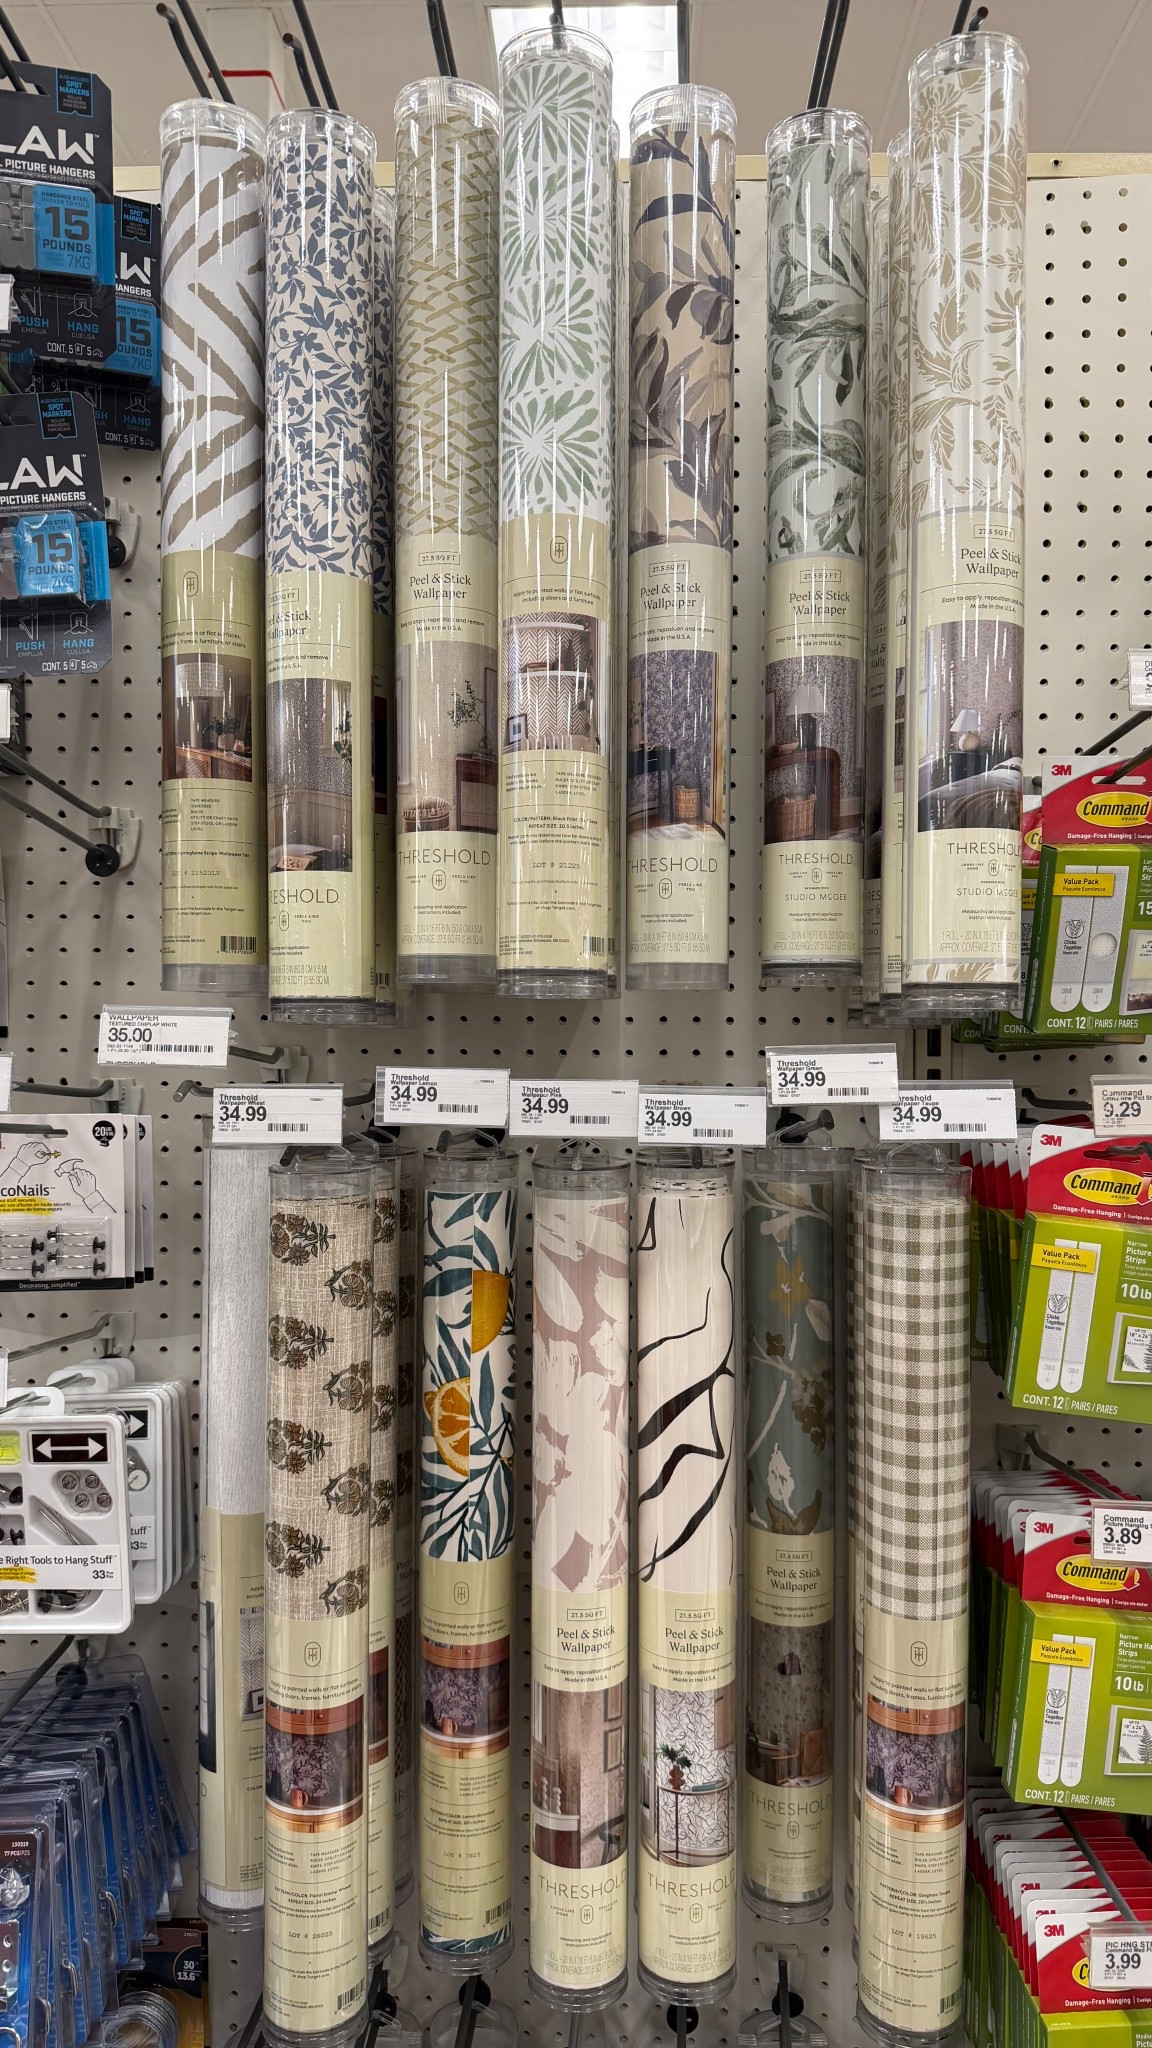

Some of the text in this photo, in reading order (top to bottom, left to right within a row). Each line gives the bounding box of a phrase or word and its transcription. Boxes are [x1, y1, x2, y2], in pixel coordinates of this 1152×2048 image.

[66, 80, 82, 88] SPOT
[60, 86, 90, 96] MARKERS
[5, 158, 47, 173] PICTURE
[50, 164, 96, 180] HANGERS
[45, 206, 90, 240] 15
[43, 239, 91, 254] POUNDS
[67, 254, 90, 270] 7KG
[19, 315, 49, 328] PUSH
[68, 322, 99, 334] HANG
[116, 316, 152, 347] 15
[131, 356, 152, 371] 7KG
[42, 410, 72, 418] MARKERS
[48, 403, 64, 412] SPOT
[124, 415, 151, 427] HANG
[0, 492, 86, 505] PICTURE HANGERS
[32, 532, 72, 564] 15
[960, 548, 1022, 566] Peel Stick
[966, 562, 1019, 578] Wallpaper
[410, 573, 472, 586] Peel Stick
[414, 588, 467, 600] Wallpaper
[640, 584, 659, 598] Peel
[790, 590, 850, 603] Peel & Stick
[644, 598, 696, 610] Wallpaper
[794, 604, 847, 616] Wallpaper
[16, 640, 44, 650] PUSH
[64, 638, 94, 649] HANG
[1050, 764, 1072, 776] 3M
[1082, 801, 1150, 816] Command
[1108, 832, 1132, 840] Hanging
[398, 848, 492, 866] THRESHOLD
[778, 853, 853, 866] THRESHOLD
[627, 857, 718, 874] THRESHOLD
[1063, 878, 1082, 886] Value
[785, 894, 816, 902] STUDIO
[956, 888, 992, 896] STUDIO
[1004, 1024, 1029, 1034] CONT.
[1046, 1016, 1139, 1030] CONT. 12 PAIRS PARES
[108, 1028, 152, 1042] 35.00
[778, 1071, 826, 1088] 34.99
[390, 1086, 438, 1102] 34.99
[522, 1098, 569, 1114] 34.99
[1103, 1101, 1142, 1118] 9.29
[220, 1106, 266, 1122] 34.99
[645, 1110, 692, 1126] 34.99
[893, 1106, 942, 1122] 34.99
[1040, 1134, 1062, 1146] 3M
[1070, 1174, 1142, 1196] Command
[1052, 1203, 1122, 1218] Damage-Free Hanging
[1042, 1248, 1080, 1261] Value Pack
[1126, 1247, 1152, 1256] Picture
[1041, 1258, 1060, 1266] Paquete
[1125, 1256, 1146, 1264] Strips
[1121, 1283, 1139, 1298] 10
[1022, 1394, 1118, 1414] CONT. 12 PAIRS PARES
[1103, 1514, 1144, 1524] Command
[1033, 1522, 1054, 1534] 3M
[1125, 1522, 1148, 1530] Hanging
[1104, 1526, 1142, 1545] 3.89
[6, 1554, 113, 1566] Right Tools to Hang Stuff
[92, 1570, 106, 1580] 33
[766, 1566, 822, 1578] Peel & Stick
[1062, 1562, 1128, 1582] Command
[770, 1579, 818, 1592] Wallpaper
[1046, 1592, 1110, 1604] Damage-Free Hanging
[556, 1625, 616, 1639] Peel & Stick
[665, 1626, 724, 1640] Peel & Stick
[560, 1640, 612, 1655] Wallpaper
[669, 1640, 720, 1655] Wallpaper
[1041, 1644, 1077, 1656] Value Pack
[1118, 1640, 1142, 1649] Picture
[1118, 1648, 1138, 1657] Strips
[1115, 1676, 1144, 1692] 10 lb
[750, 1790, 832, 1816] THRESHOLD
[1025, 1789, 1116, 1806] CONT. 12 PAIRS PARES
[538, 1868, 627, 1899] THRESHOLD
[647, 1868, 736, 1898] THRESHOLD
[1044, 1924, 1065, 1937] 3M
[183, 1960, 195, 1970] 30
[1105, 1953, 1142, 1970] 3.99
[176, 1972, 196, 1981] 13.6
[1065, 1997, 1132, 2007] Damage-Free Hanging
